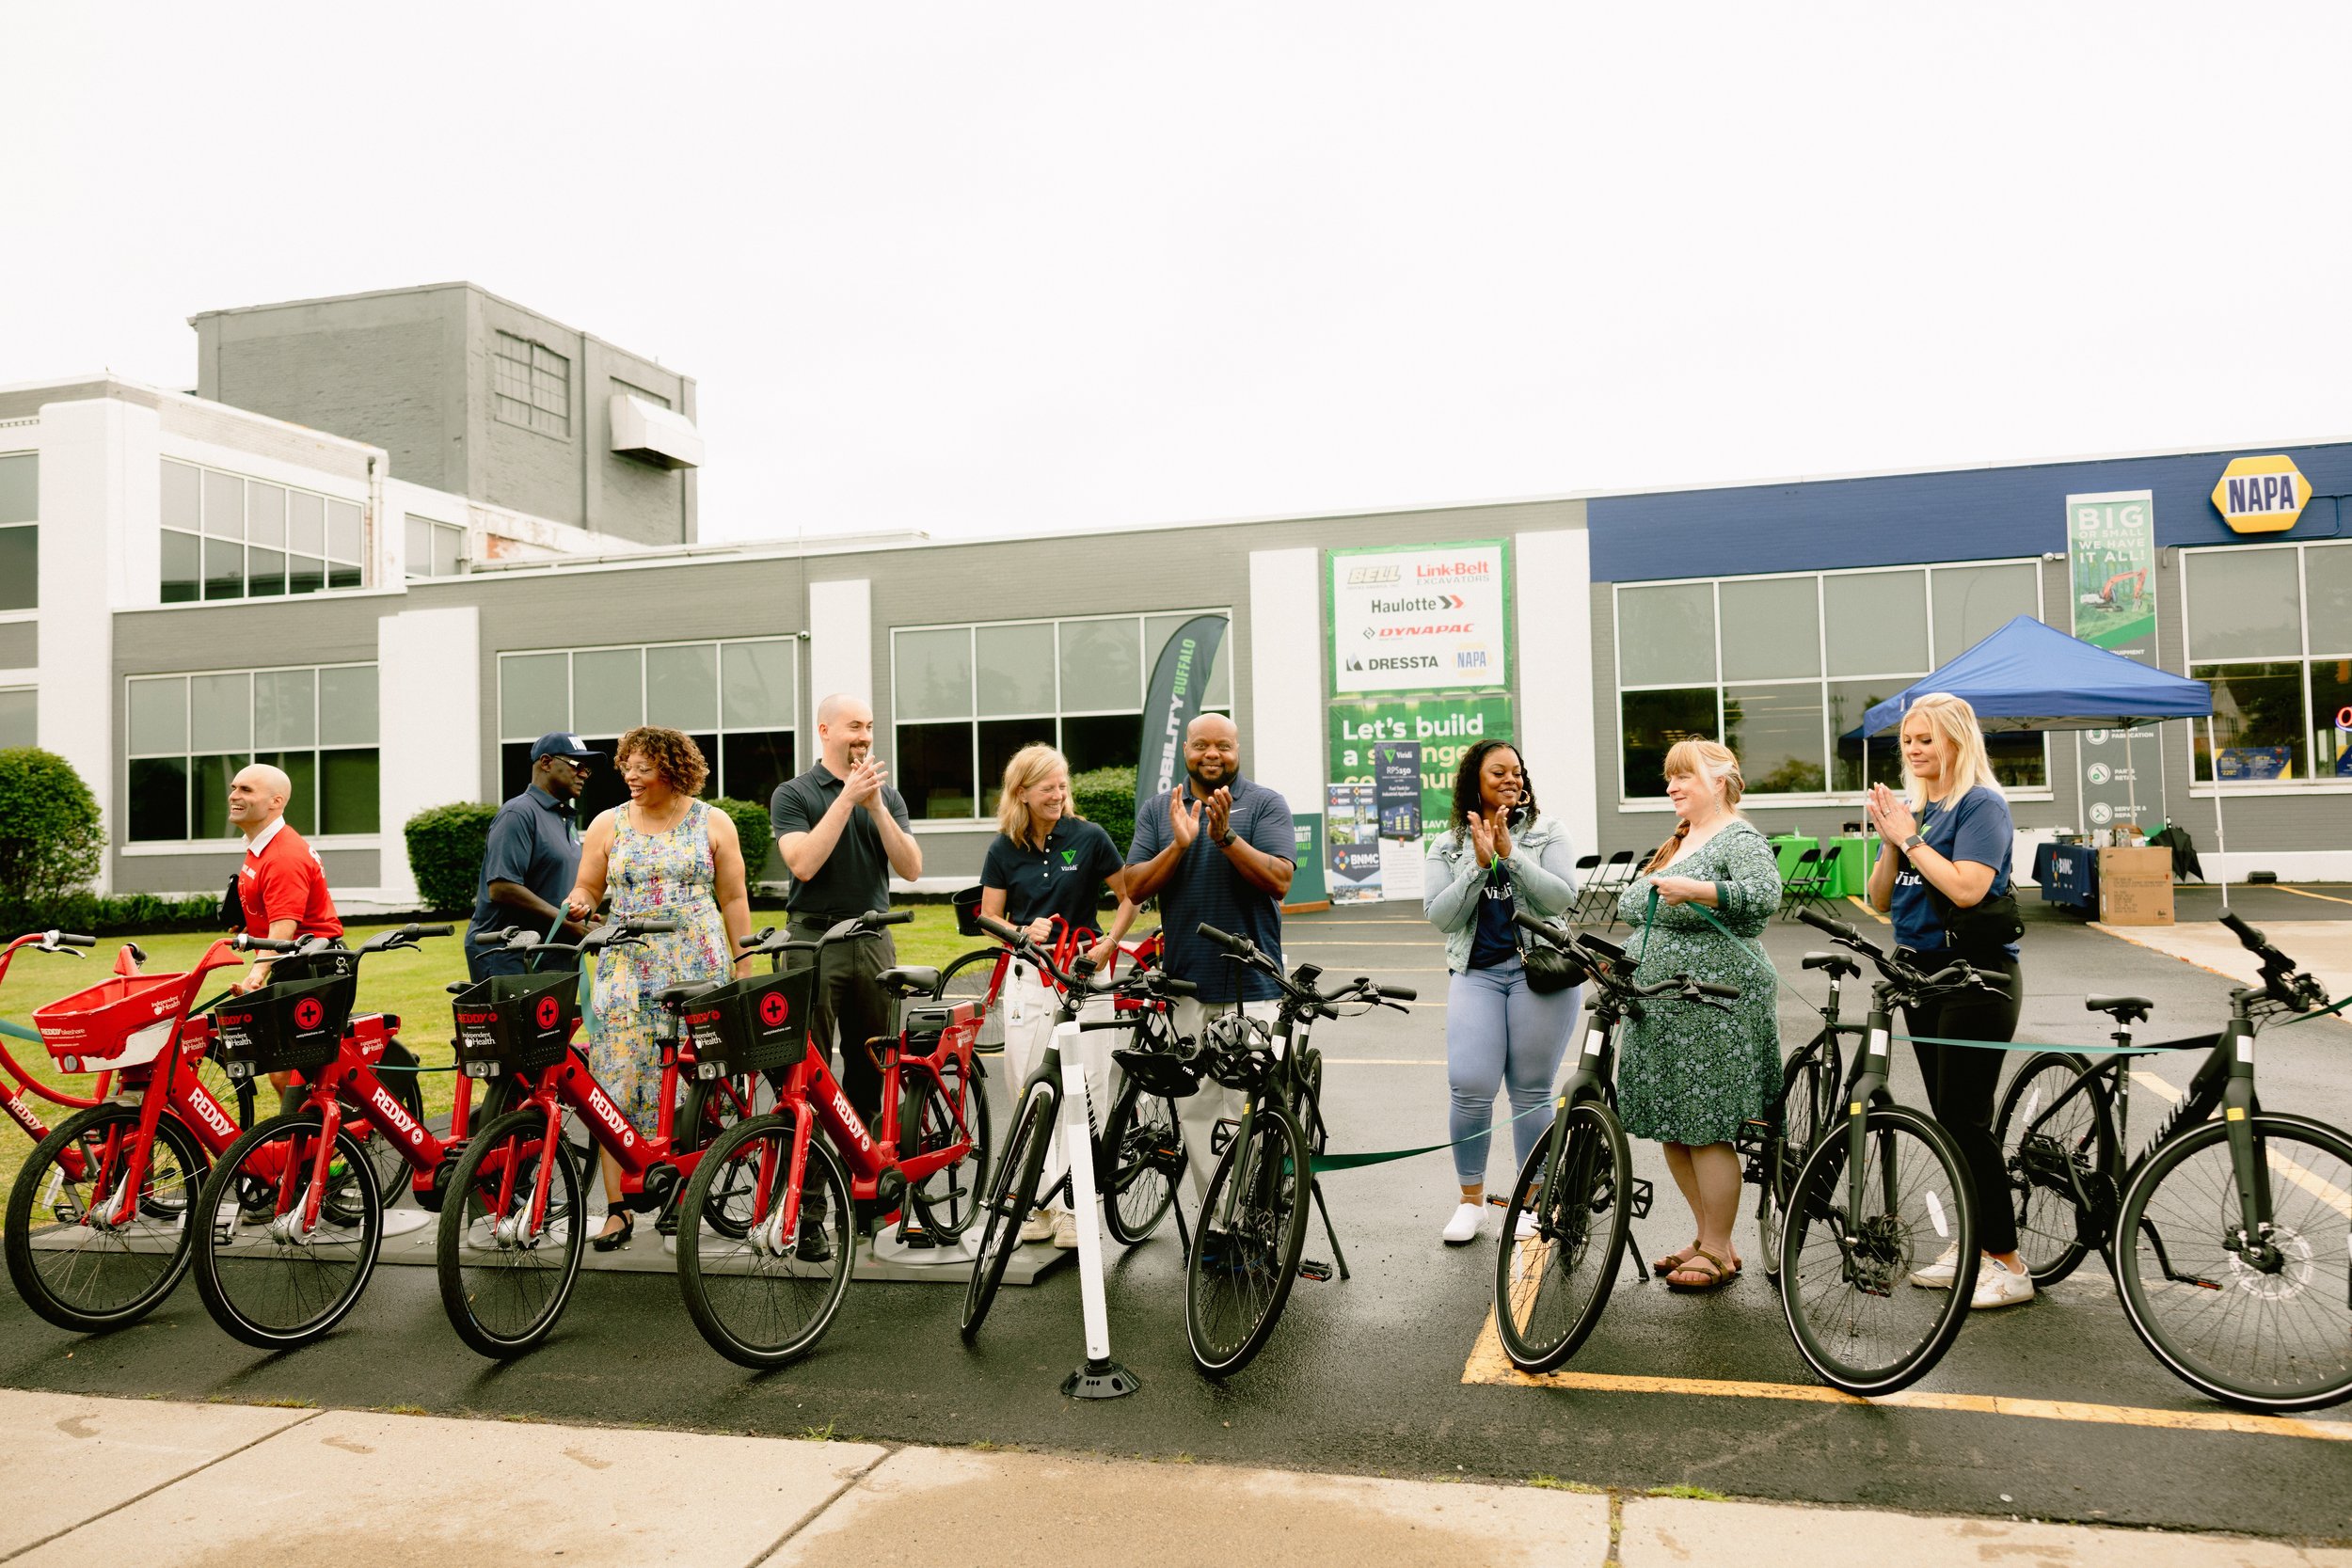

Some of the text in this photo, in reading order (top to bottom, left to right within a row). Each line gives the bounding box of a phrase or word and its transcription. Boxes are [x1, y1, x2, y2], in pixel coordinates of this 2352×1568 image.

[2229, 475, 2296, 514] NAPA
[2077, 505, 2144, 531] BIG
[2078, 528, 2145, 540] OR SMALL
[2078, 537, 2146, 550] WE HAVE
[2079, 549, 2145, 563] IT ALL!
[1347, 564, 1402, 584] BELL
[1416, 561, 1489, 578] Link-Belt
[1416, 575, 1490, 586] EXCAVATORS
[1371, 597, 1437, 613] Haulotte
[1378, 623, 1475, 638] DYNAPAC
[1369, 656, 1439, 671] DRESSTA
[1457, 650, 1486, 669] NAPA
[1157, 638, 1196, 795] OBILITY BUFFALO
[1343, 713, 1484, 740] Let's build
[1343, 749, 1359, 767] a
[1422, 819, 1449, 829] EAVY
[1350, 853, 1379, 865] BNMC
[456, 1012, 488, 1024] REDDY
[231, 1037, 253, 1047] Health
[472, 1037, 497, 1047] Health
[701, 1036, 723, 1046] Health
[8, 1095, 46, 1130] REDDY
[188, 1086, 235, 1137] REDDY
[372, 1086, 417, 1133] REDDY
[587, 1086, 628, 1134] REDDY
[833, 1090, 865, 1139] REDDY
[2144, 1084, 2192, 1161] AVENTON
